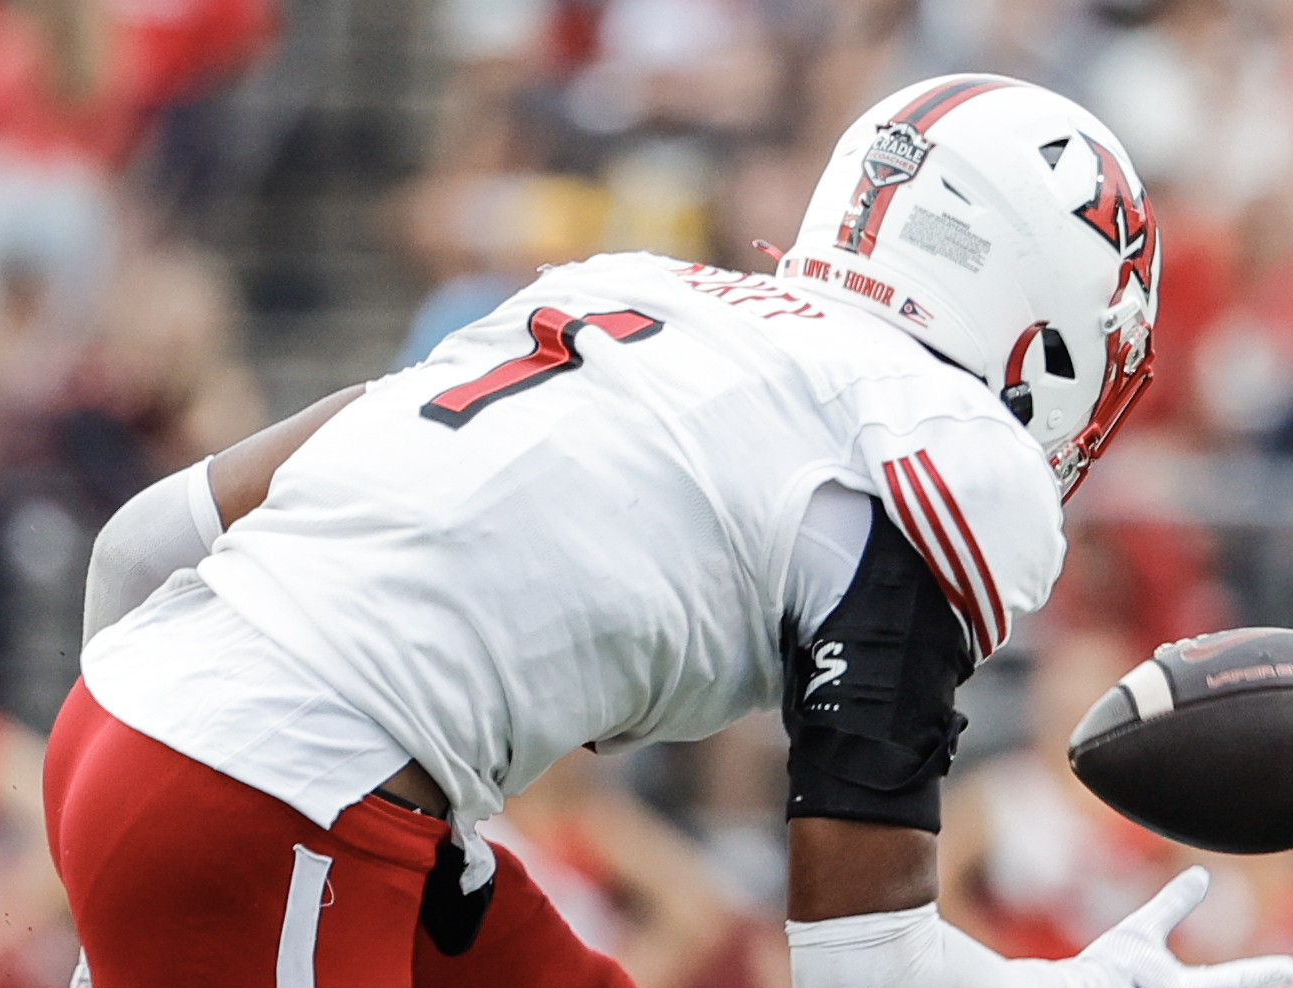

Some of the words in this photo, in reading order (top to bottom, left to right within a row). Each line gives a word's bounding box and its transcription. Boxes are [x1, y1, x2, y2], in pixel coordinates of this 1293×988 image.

[872, 137, 926, 165] CRADLE
[802, 257, 832, 282] LOVE
[843, 269, 895, 307] HONOR
[418, 306, 665, 431] 1
